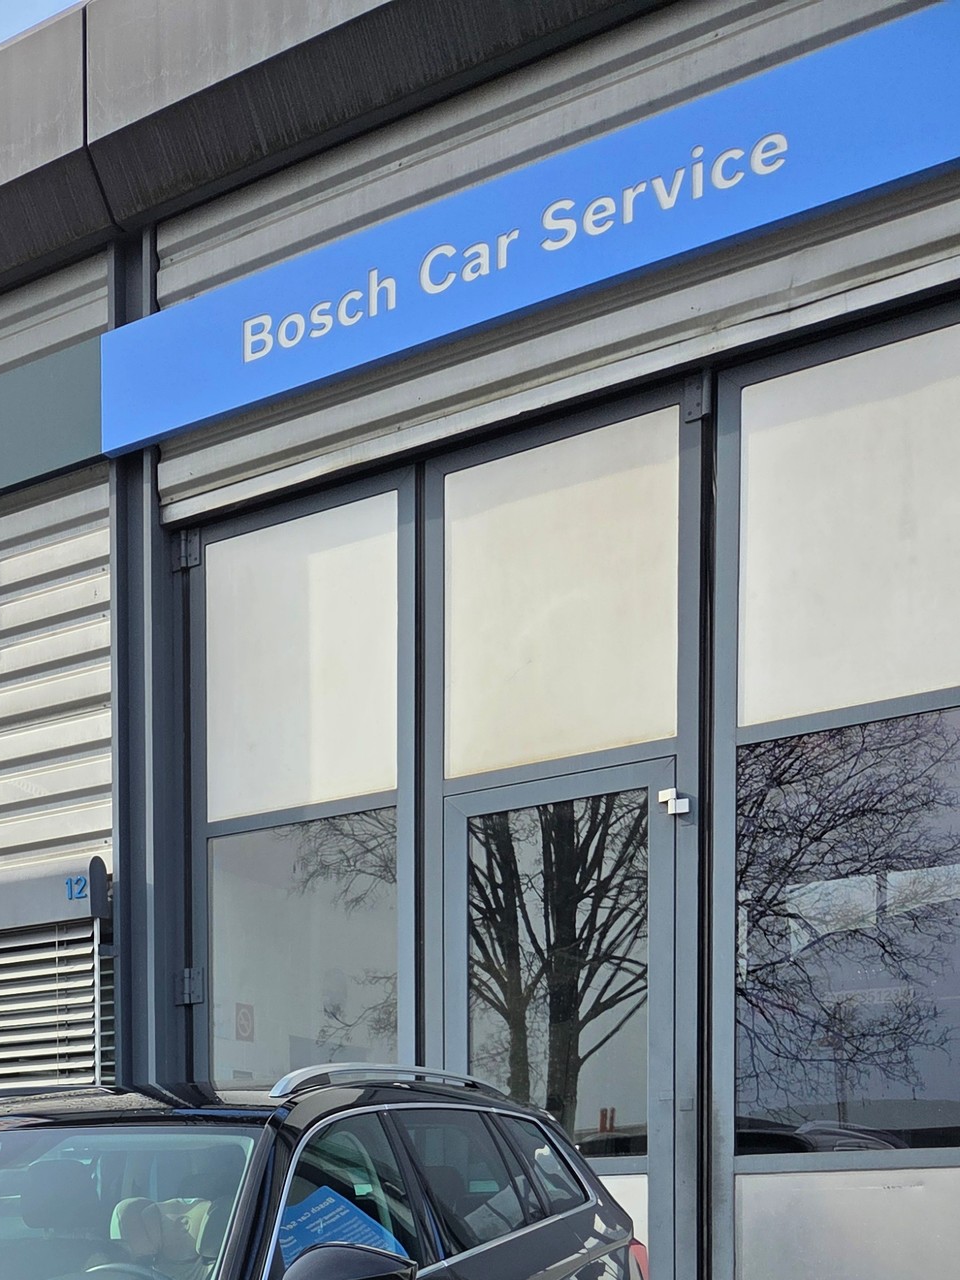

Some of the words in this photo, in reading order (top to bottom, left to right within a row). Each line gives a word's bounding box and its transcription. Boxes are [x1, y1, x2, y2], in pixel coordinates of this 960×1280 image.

[243, 268, 397, 364] Bosch
[419, 228, 520, 295] Car
[541, 132, 789, 251] Service
[65, 875, 88, 900] 12
